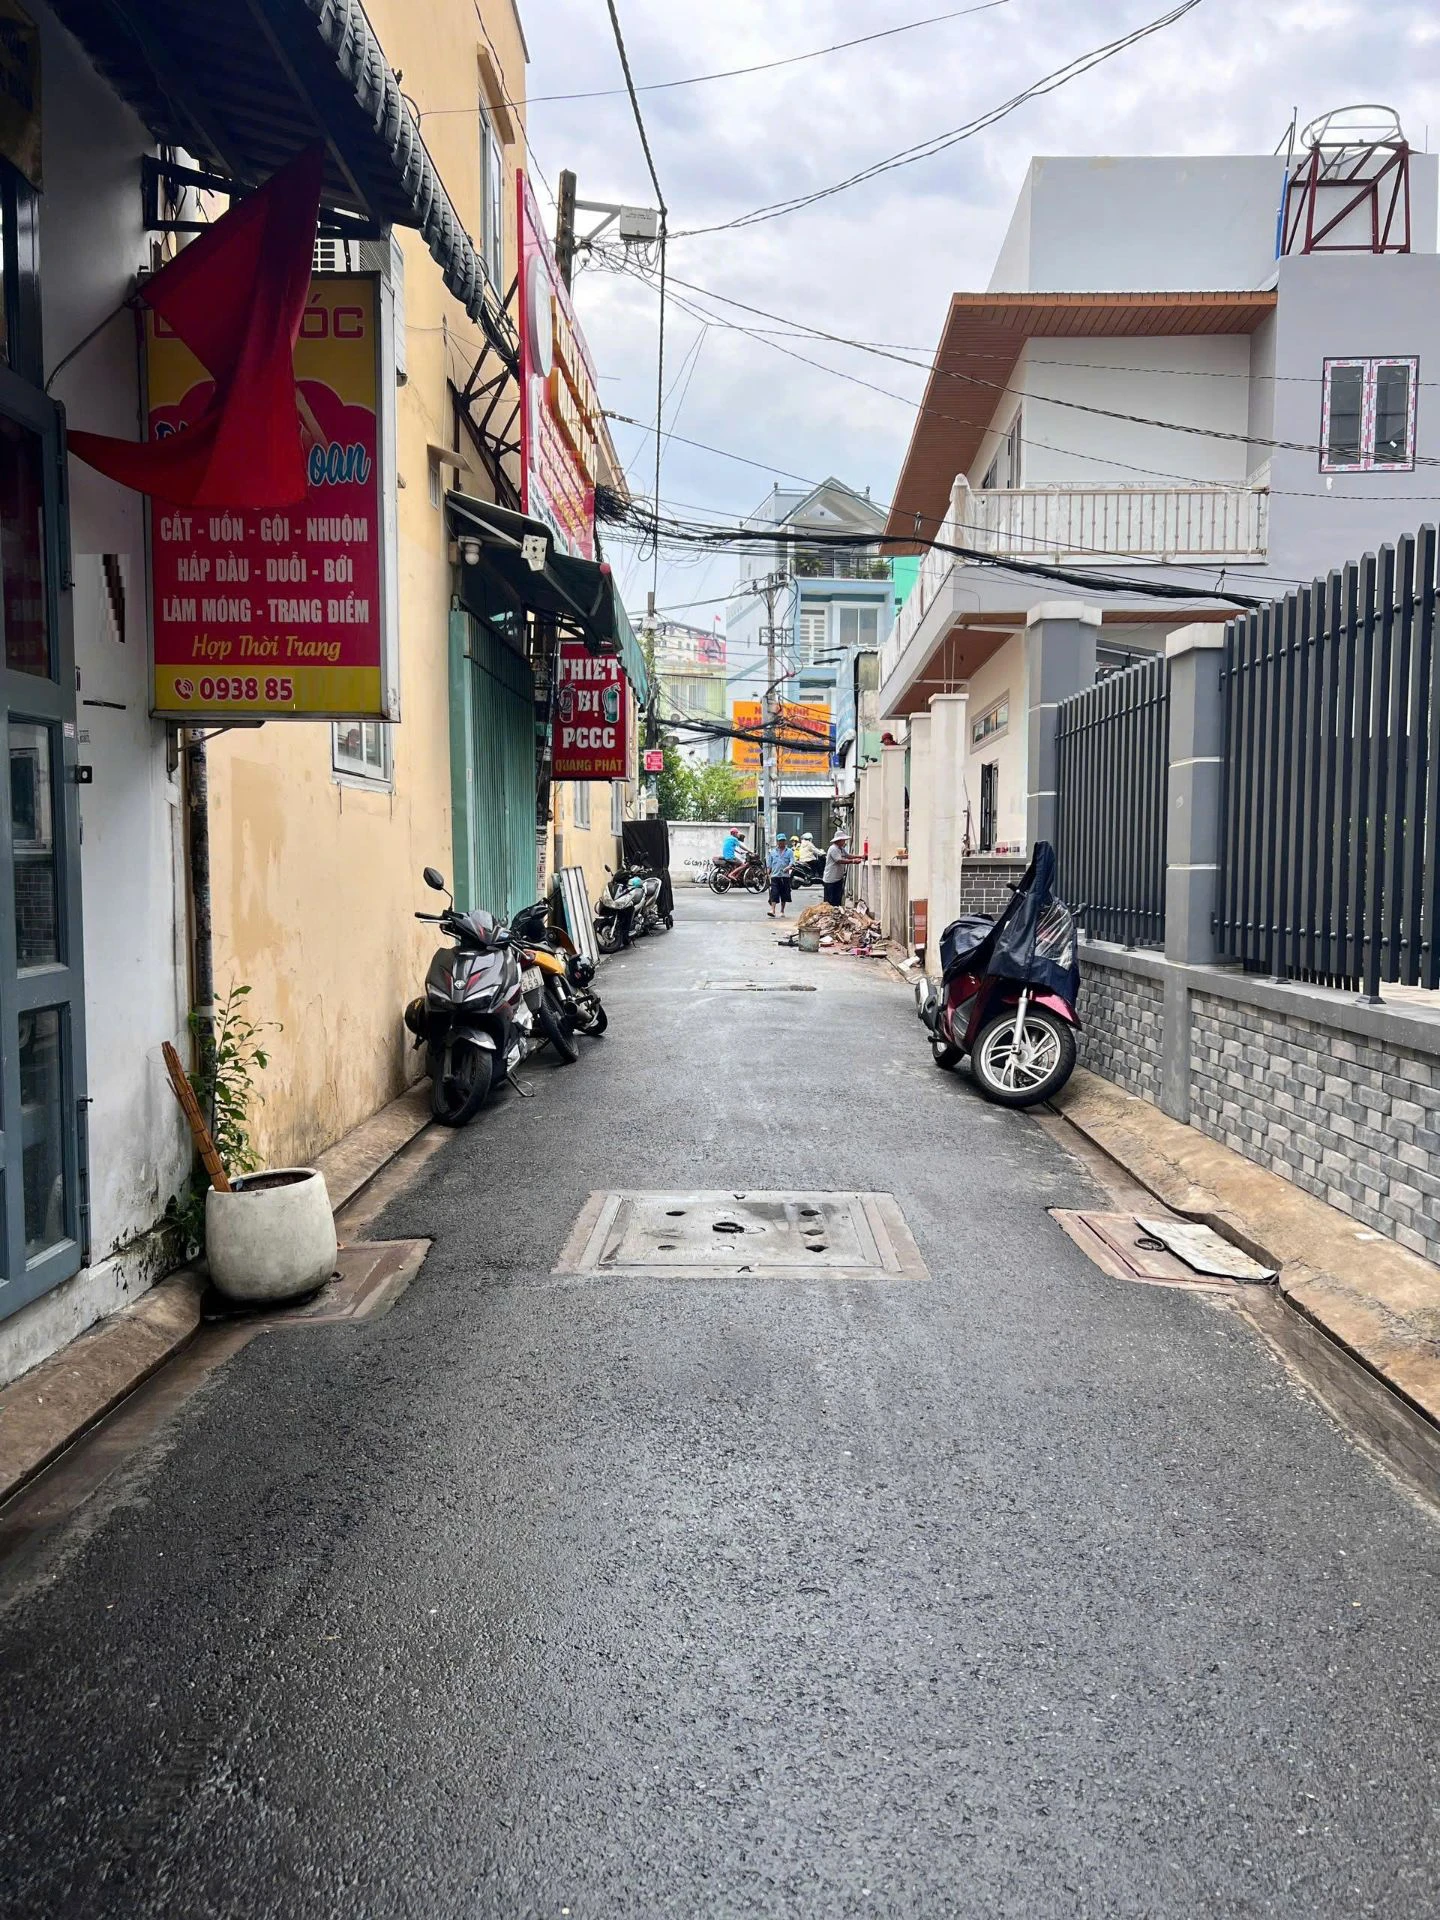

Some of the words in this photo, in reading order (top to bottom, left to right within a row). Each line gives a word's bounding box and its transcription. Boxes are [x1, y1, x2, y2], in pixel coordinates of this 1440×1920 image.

[300, 293, 364, 338] ÓC
[308, 441, 372, 487] oan
[160, 510, 193, 542] CẮT
[209, 510, 244, 542] UỐN
[260, 513, 290, 546] GỘI
[306, 513, 368, 546] NHUỘM
[177, 551, 210, 582] HẤP
[216, 551, 249, 582] DẦU
[266, 551, 307, 582] DUỖI
[163, 594, 196, 622] LÀM
[202, 594, 251, 623] MÓNG
[268, 598, 322, 623] TRANG
[327, 591, 369, 623] ĐIỂM
[192, 633, 232, 660] Hợp
[239, 634, 279, 657] Thời
[286, 635, 341, 661] Trang
[199, 677, 259, 701] 0938
[264, 677, 293, 701] 85
[562, 727, 616, 749] PCCC
